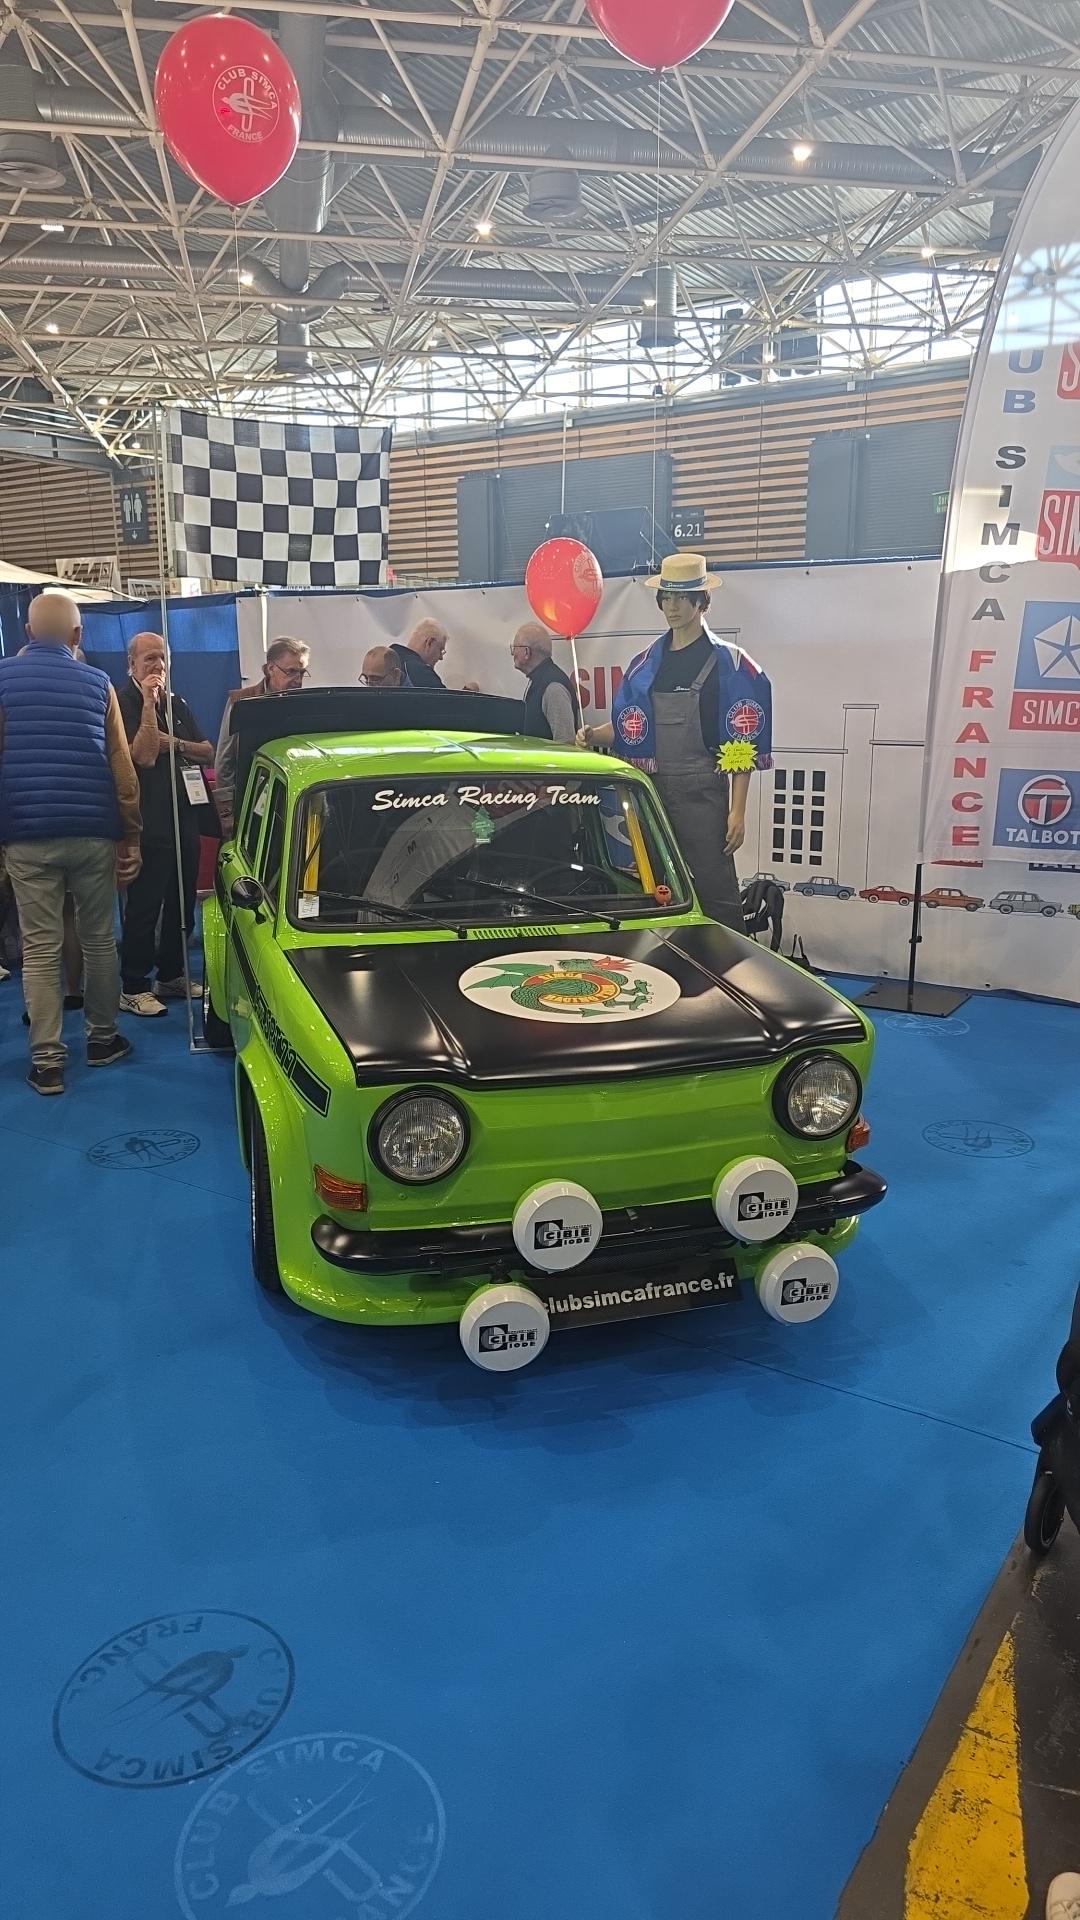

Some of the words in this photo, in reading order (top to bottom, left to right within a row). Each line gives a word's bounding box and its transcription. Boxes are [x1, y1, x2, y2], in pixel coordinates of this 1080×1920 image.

[218, 68, 246, 90] CLUB
[251, 71, 278, 109] SIMCA
[227, 124, 263, 140] FRANCE
[674, 523, 702, 538] 6.21
[971, 445, 1027, 621] SIMCA
[620, 707, 635, 720] CLUB
[729, 701, 743, 718] CLUB
[1022, 700, 1080, 726] SIMC
[951, 650, 997, 846] FRANCE
[371, 789, 448, 811] Simca
[457, 785, 539, 810] Racing
[546, 785, 602, 805] Team
[1006, 827, 1080, 845] TALBOT
[764, 1210, 790, 1218] IODE
[563, 1237, 591, 1246] IODE
[543, 1271, 735, 1314] clubsimcafrance.fr
[805, 1294, 830, 1302] IODE
[509, 1341, 537, 1349] IODE
[246, 1646, 284, 1731] CUB
[94, 1744, 234, 1781] SIMCA
[184, 1789, 241, 1902] CLUB
[246, 1740, 385, 1777] SIMCA
